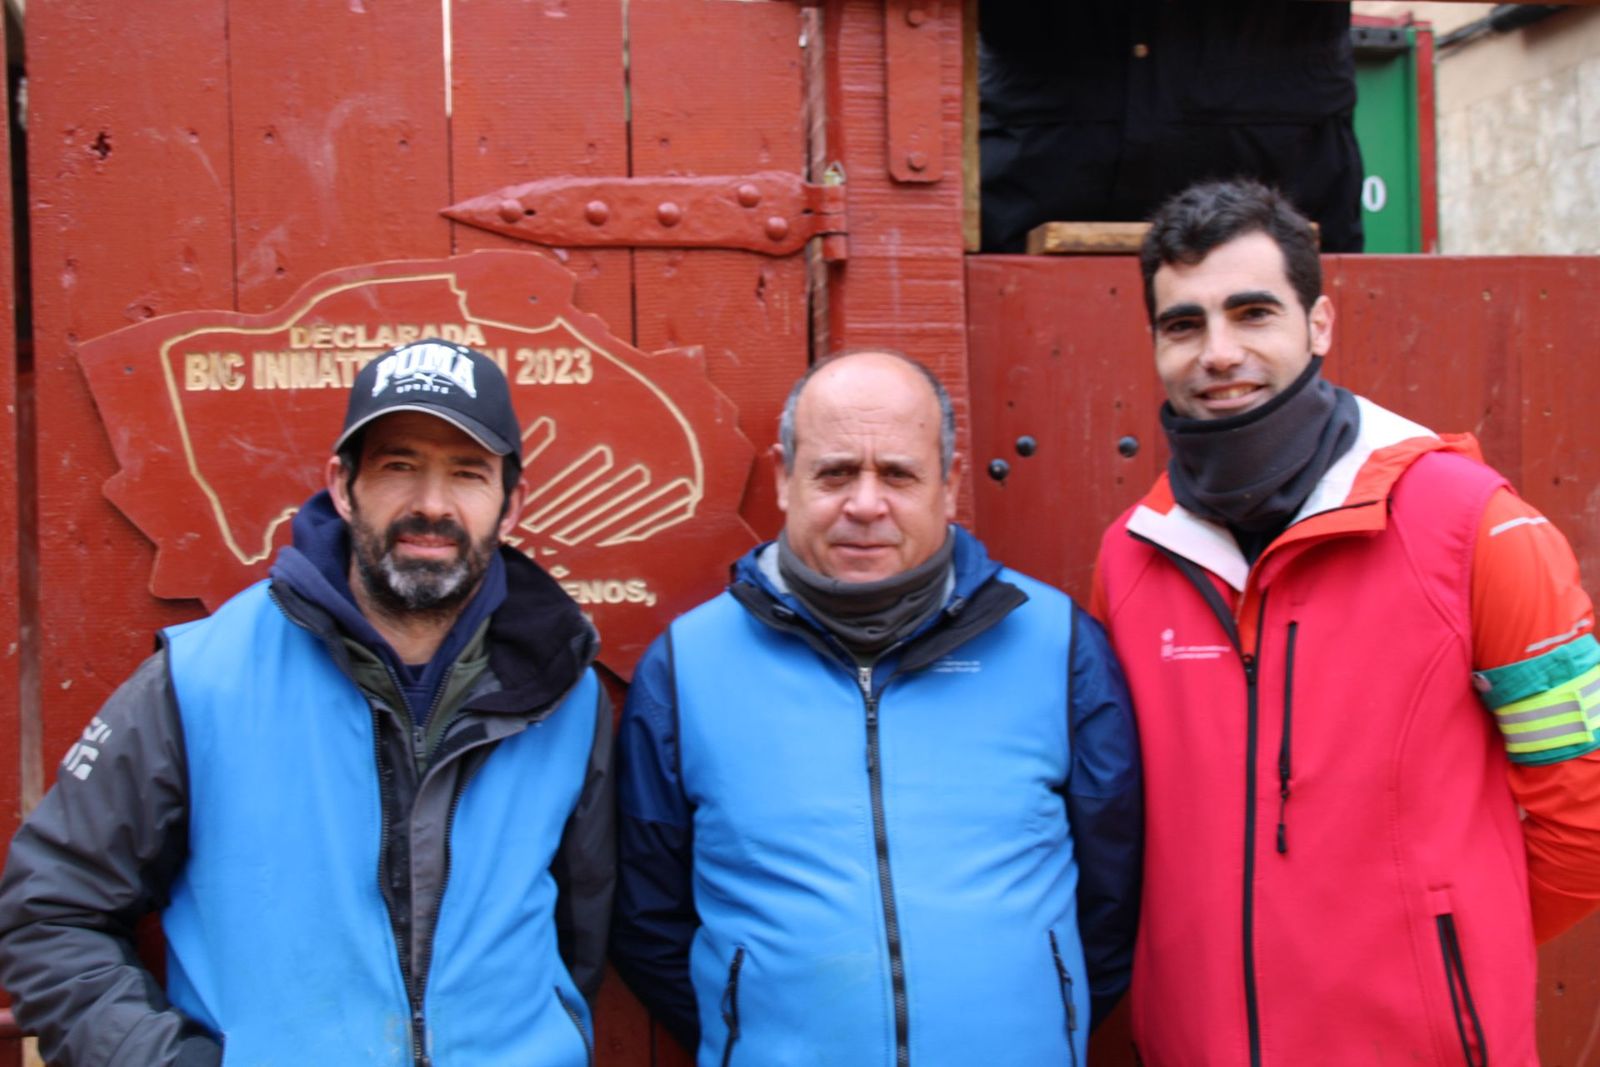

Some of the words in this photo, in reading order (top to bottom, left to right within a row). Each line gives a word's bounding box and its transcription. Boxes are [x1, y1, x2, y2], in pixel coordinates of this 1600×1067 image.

[290, 323, 487, 349] DECLARADA
[371, 343, 477, 398] PUMA
[515, 348, 594, 386] 2023
[396, 383, 450, 394] SPORTS
